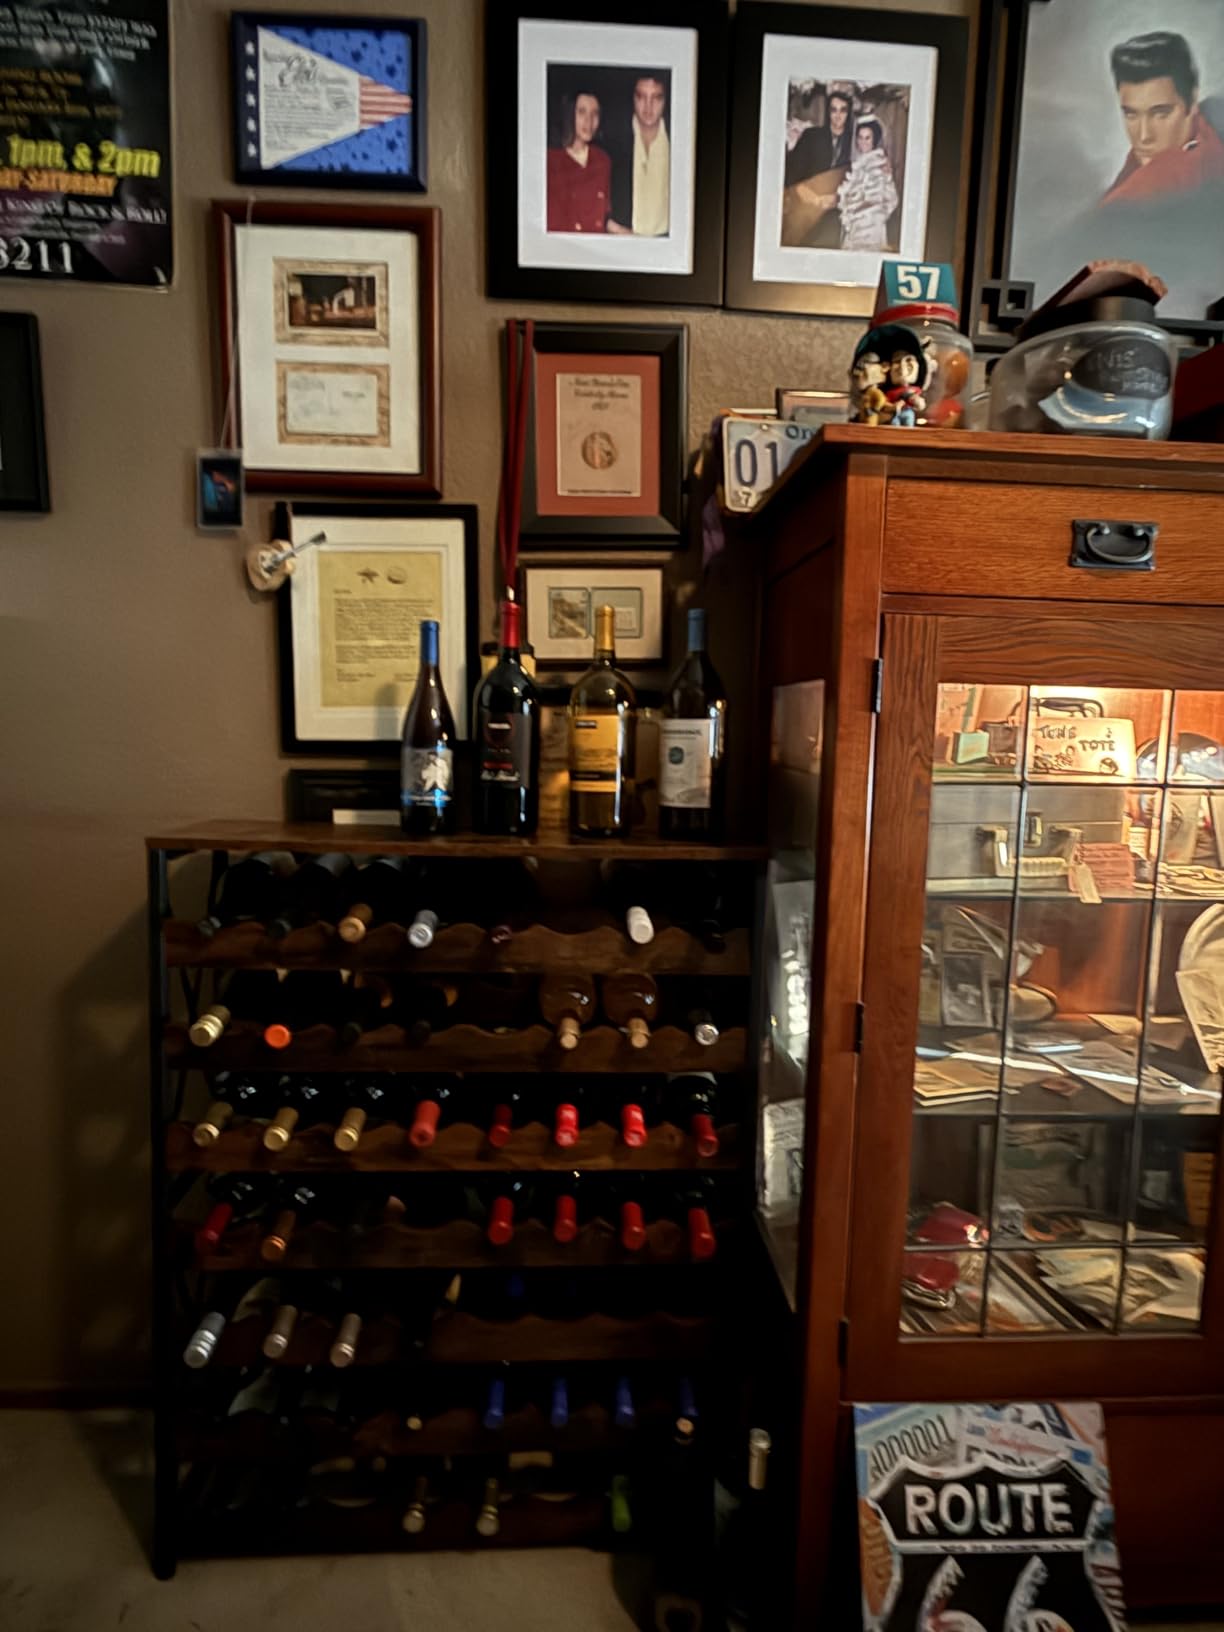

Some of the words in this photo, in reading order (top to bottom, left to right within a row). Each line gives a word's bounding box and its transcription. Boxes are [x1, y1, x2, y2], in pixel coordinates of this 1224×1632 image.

[73, 142, 93, 171] &
[98, 140, 160, 178] 2pm
[896, 265, 941, 299] 57
[735, 439, 778, 487] 01
[1079, 740, 1115, 751] TOTE
[903, 1483, 1074, 1535] ROUTE
